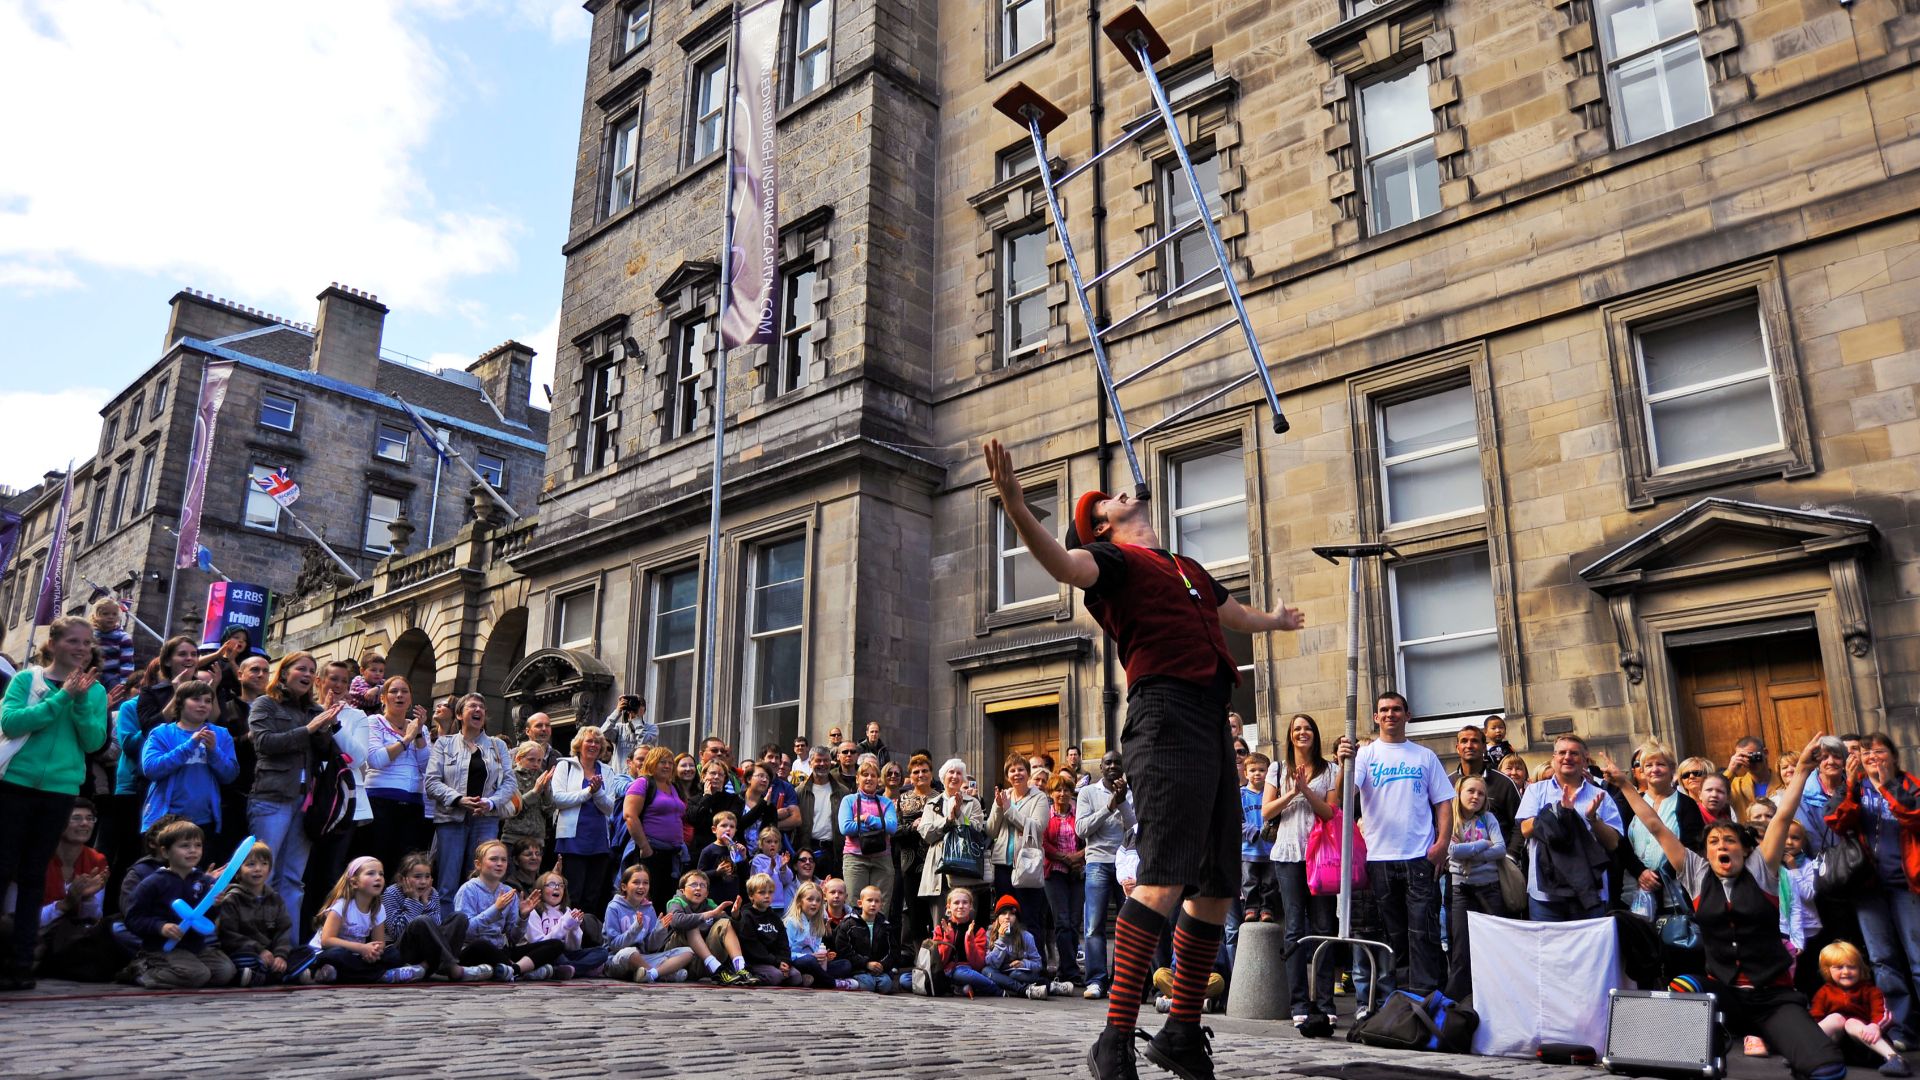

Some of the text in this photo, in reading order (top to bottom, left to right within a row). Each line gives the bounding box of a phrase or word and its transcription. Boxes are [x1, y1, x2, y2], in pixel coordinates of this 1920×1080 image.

[244, 590, 263, 603] RBS
[229, 611, 261, 627] fringe
[1370, 761, 1423, 787] Yankees
